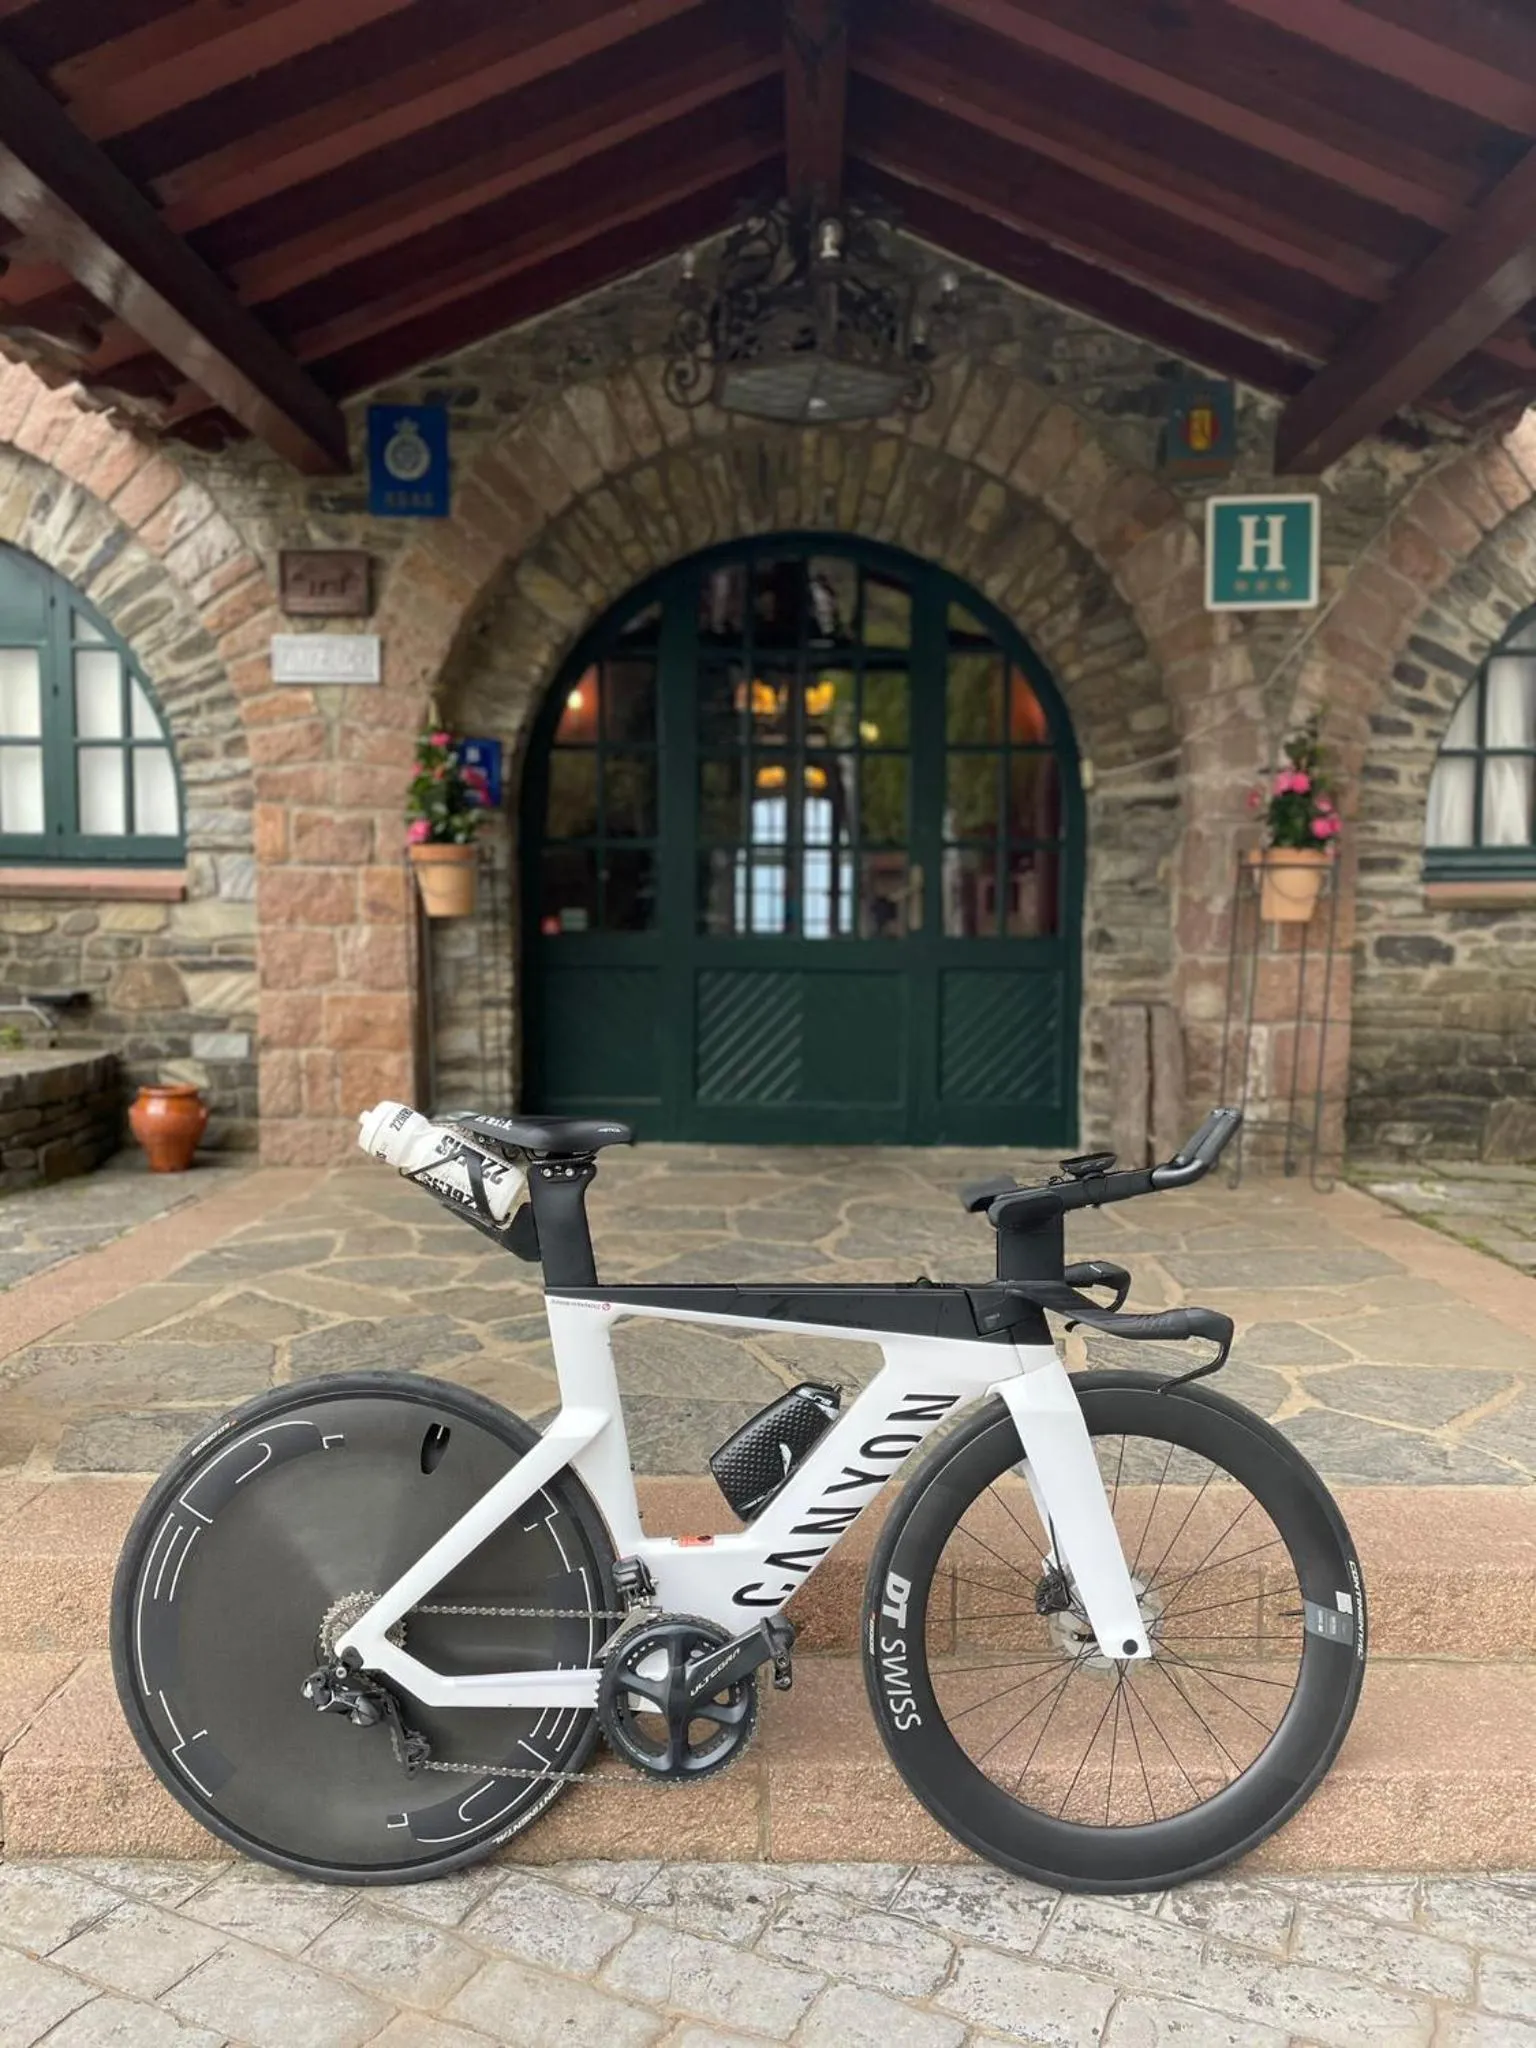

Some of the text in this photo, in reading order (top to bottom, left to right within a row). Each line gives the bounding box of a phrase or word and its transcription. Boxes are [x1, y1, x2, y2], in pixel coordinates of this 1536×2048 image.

[1237, 514, 1287, 572] H
[732, 1394, 962, 1607] CANYON
[880, 1572, 922, 1731] DT SWISS
[1348, 1560, 1364, 1660] CONTINENTAL
[492, 1779, 565, 1845] CONTINENTAL
